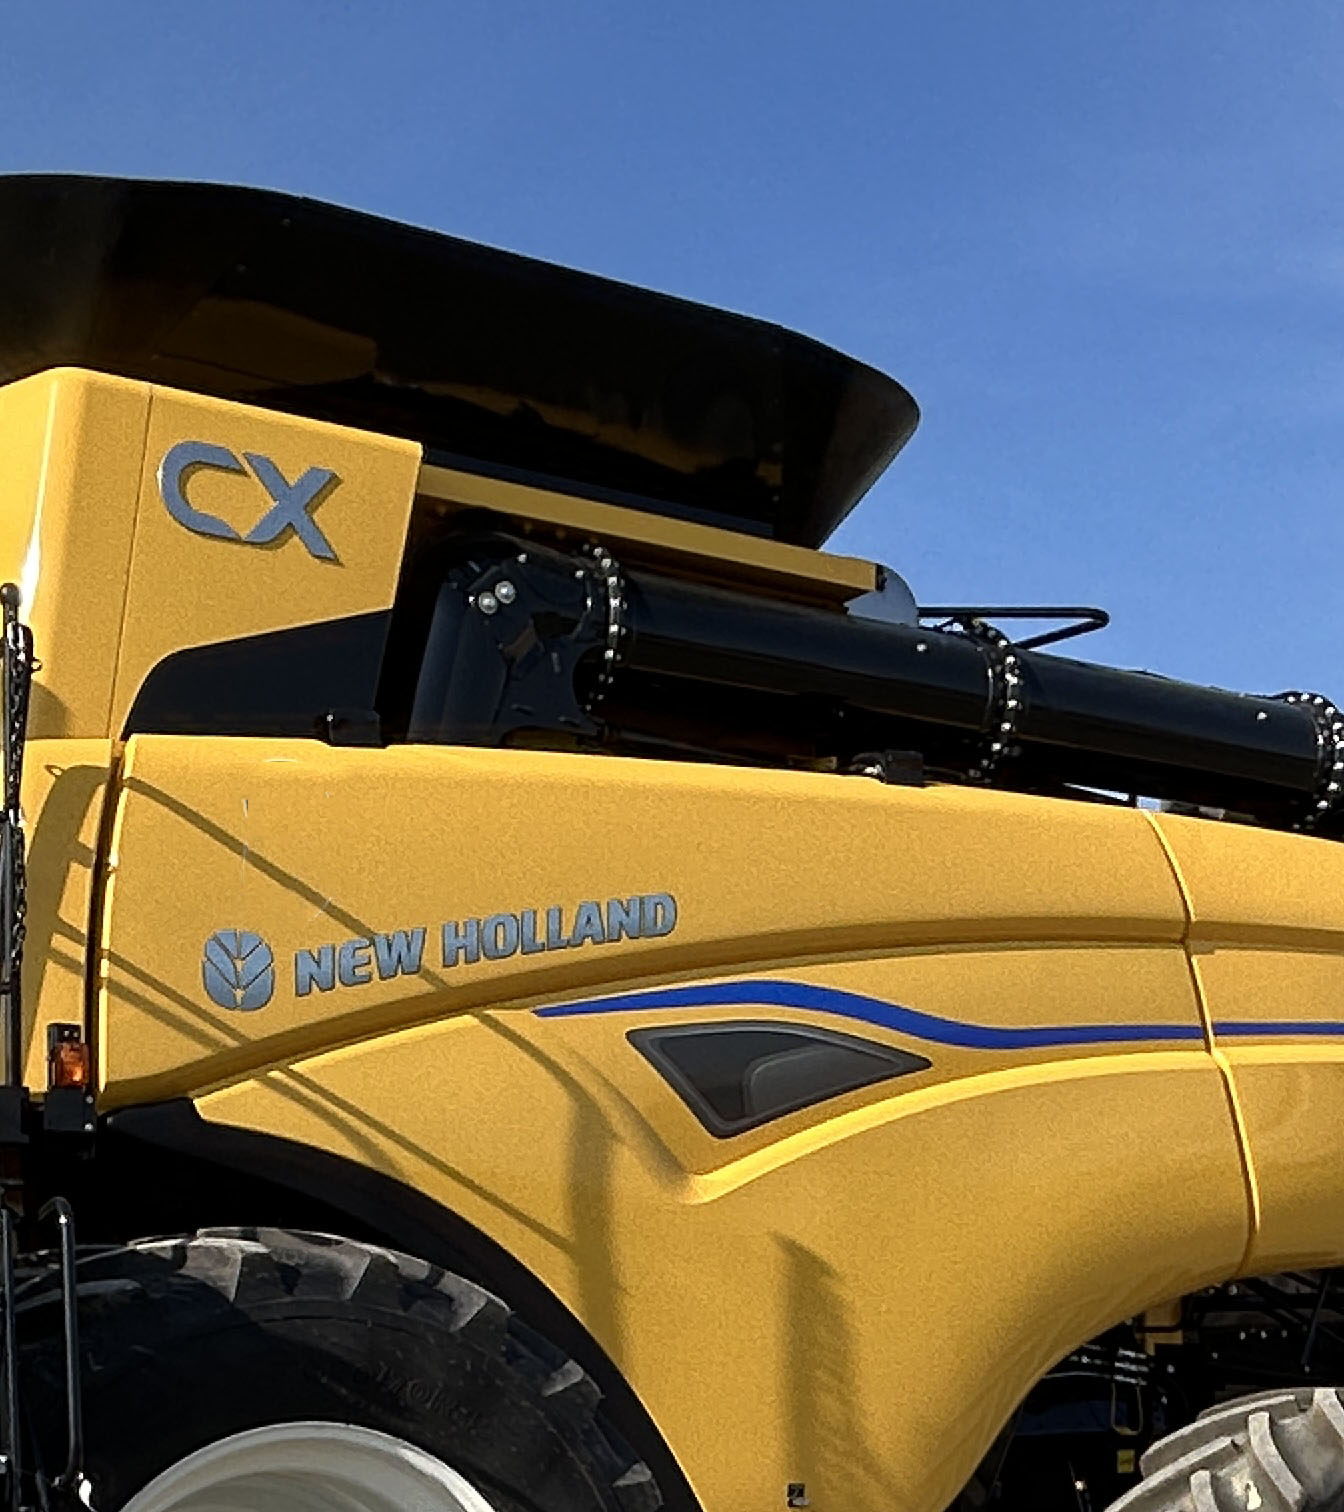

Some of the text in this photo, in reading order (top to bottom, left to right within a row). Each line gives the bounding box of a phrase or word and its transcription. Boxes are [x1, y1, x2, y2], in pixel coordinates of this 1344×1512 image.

[159, 440, 344, 565] CX
[294, 892, 678, 997] NEW HOLLAND
